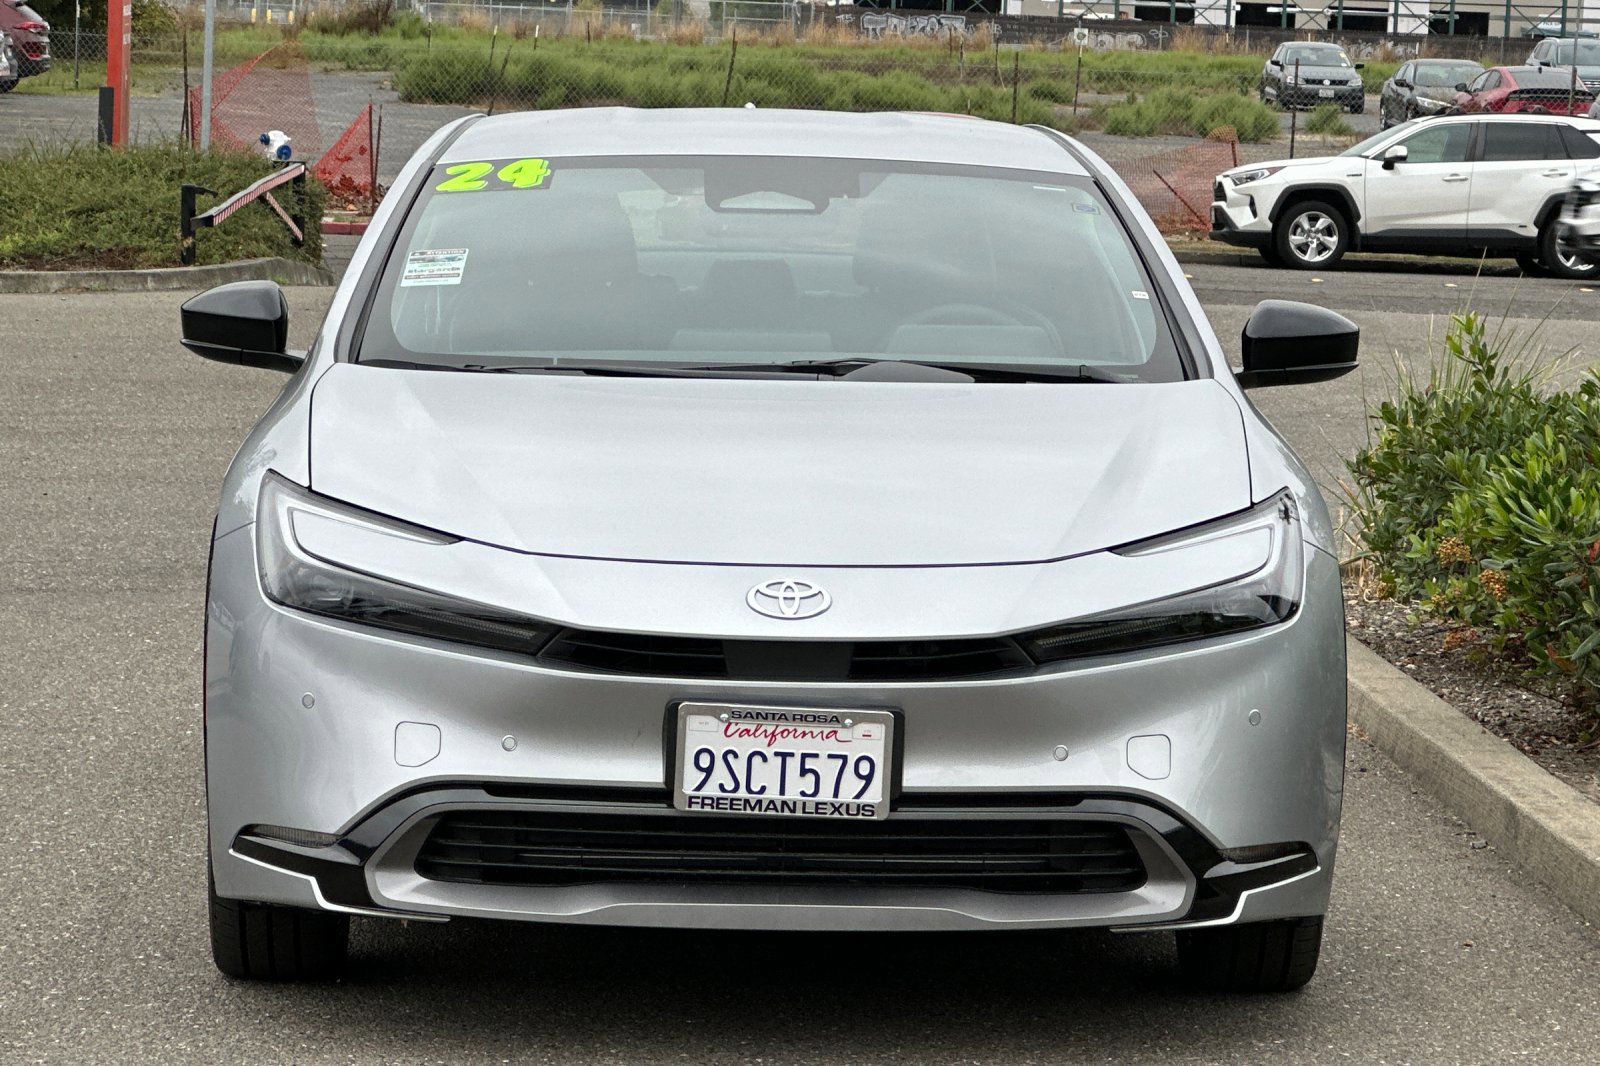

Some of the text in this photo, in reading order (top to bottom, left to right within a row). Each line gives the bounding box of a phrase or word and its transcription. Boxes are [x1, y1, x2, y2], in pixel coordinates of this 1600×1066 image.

[436, 158, 552, 193] 24
[731, 710, 841, 723] SANTA ROSA
[723, 721, 853, 747] California
[691, 747, 876, 800] 9SCT579
[687, 795, 875, 817] FREEMAN LEXUS
